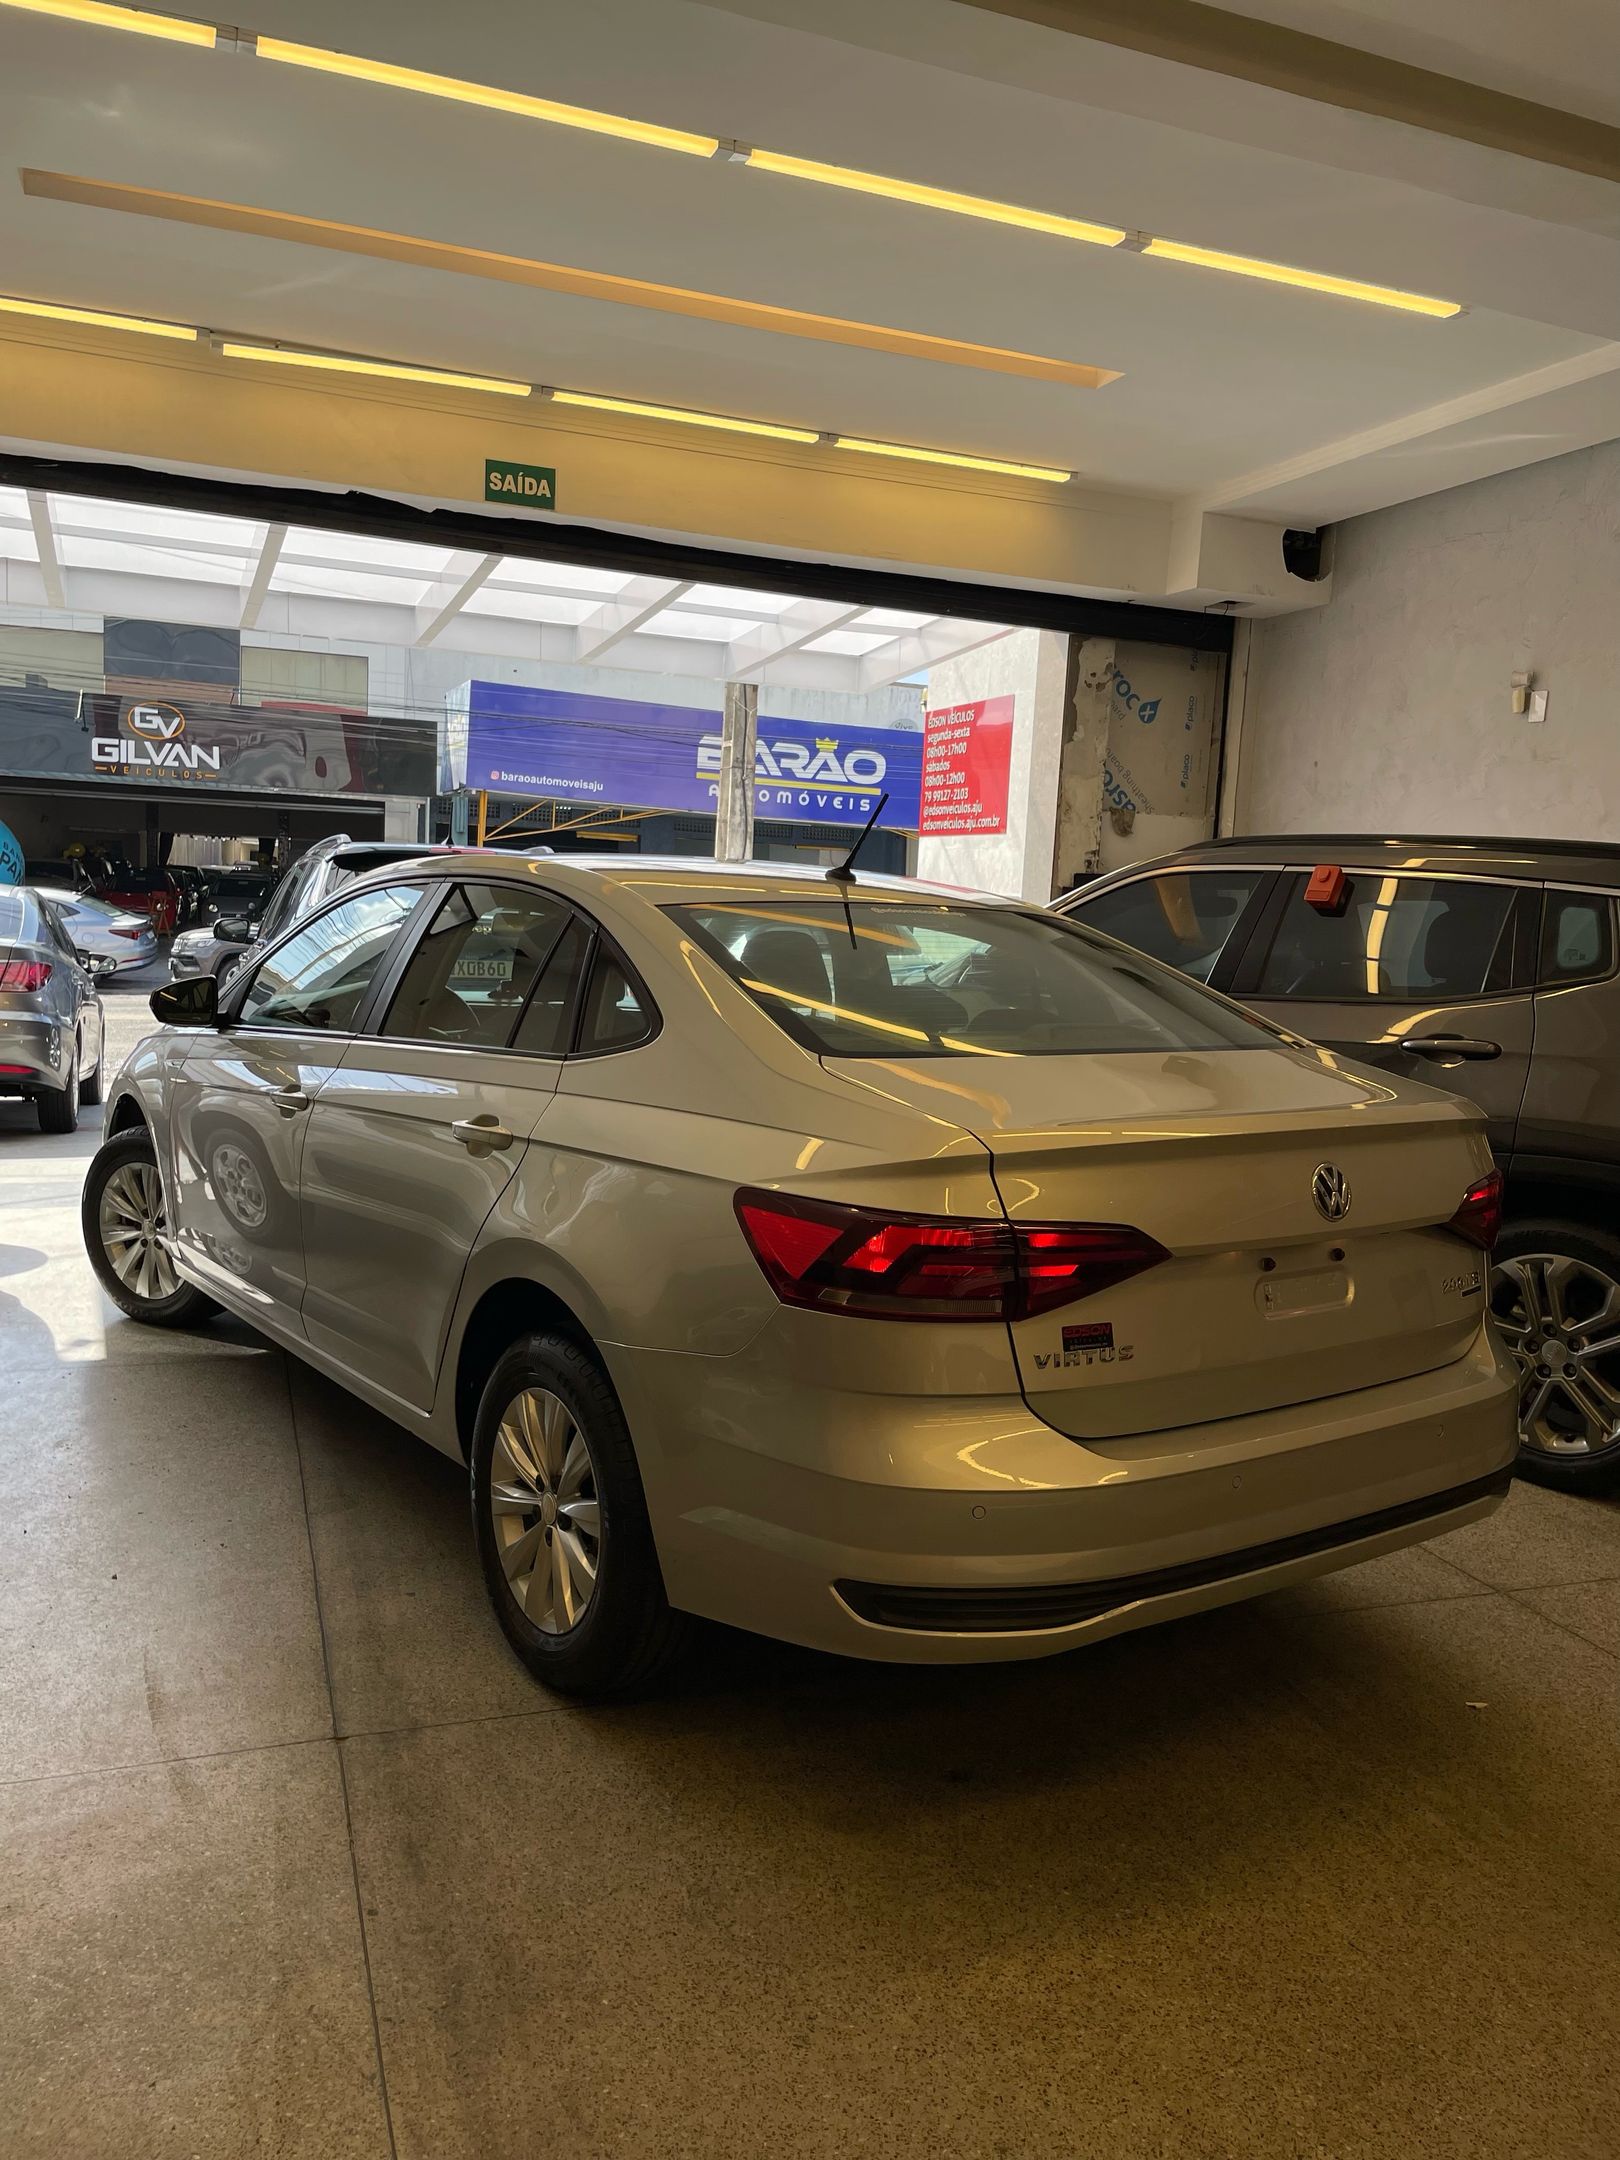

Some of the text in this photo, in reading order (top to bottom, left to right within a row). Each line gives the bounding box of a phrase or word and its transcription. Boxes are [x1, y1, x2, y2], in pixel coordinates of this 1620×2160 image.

[489, 471, 551, 498] SAÍDA
[134, 706, 180, 738] GV
[928, 716, 947, 729] EDSON
[92, 737, 220, 770] GILVAN
[501, 771, 604, 793] baraoautomoveisaju
[708, 784, 871, 811] AOMÓVEIS
[454, 960, 506, 977] X0B60
[1033, 1345, 1134, 1369] VIRTUS
